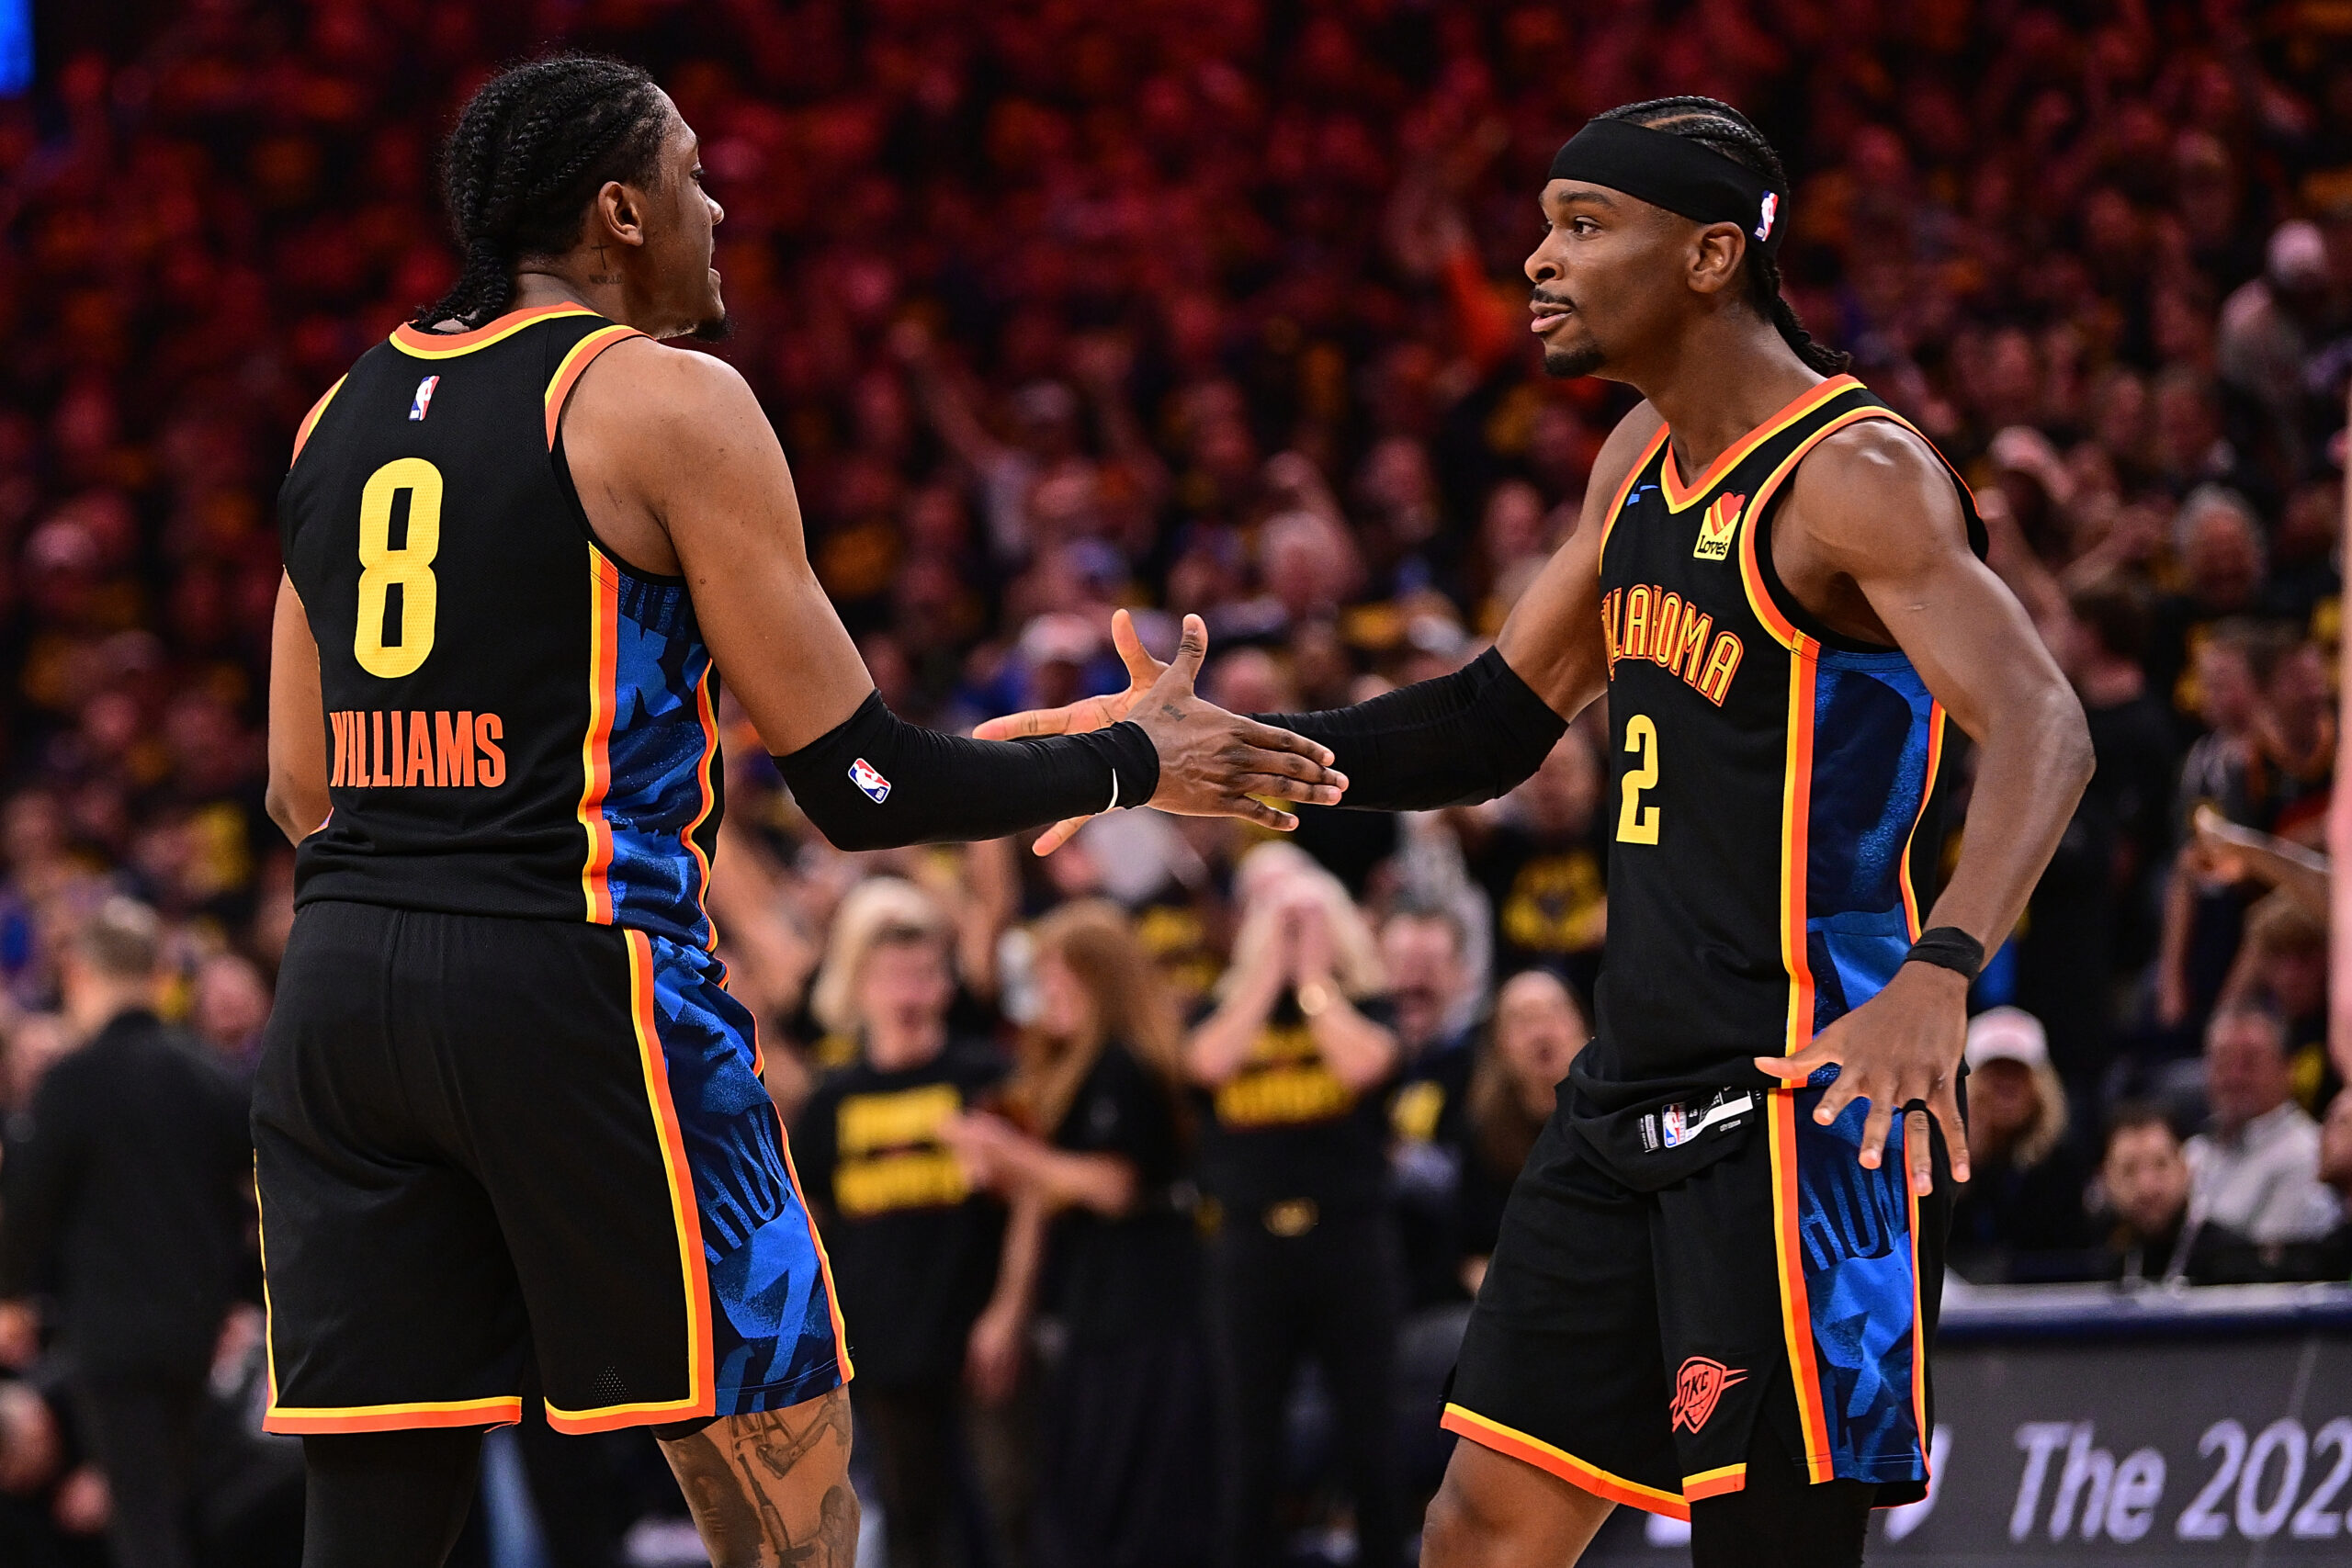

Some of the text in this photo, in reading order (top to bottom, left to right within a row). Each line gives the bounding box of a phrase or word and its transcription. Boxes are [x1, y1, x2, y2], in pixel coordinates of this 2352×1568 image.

[353, 457, 443, 679] 8
[1615, 714, 1660, 845] 2
[2008, 1416, 2352, 1543] The 202
